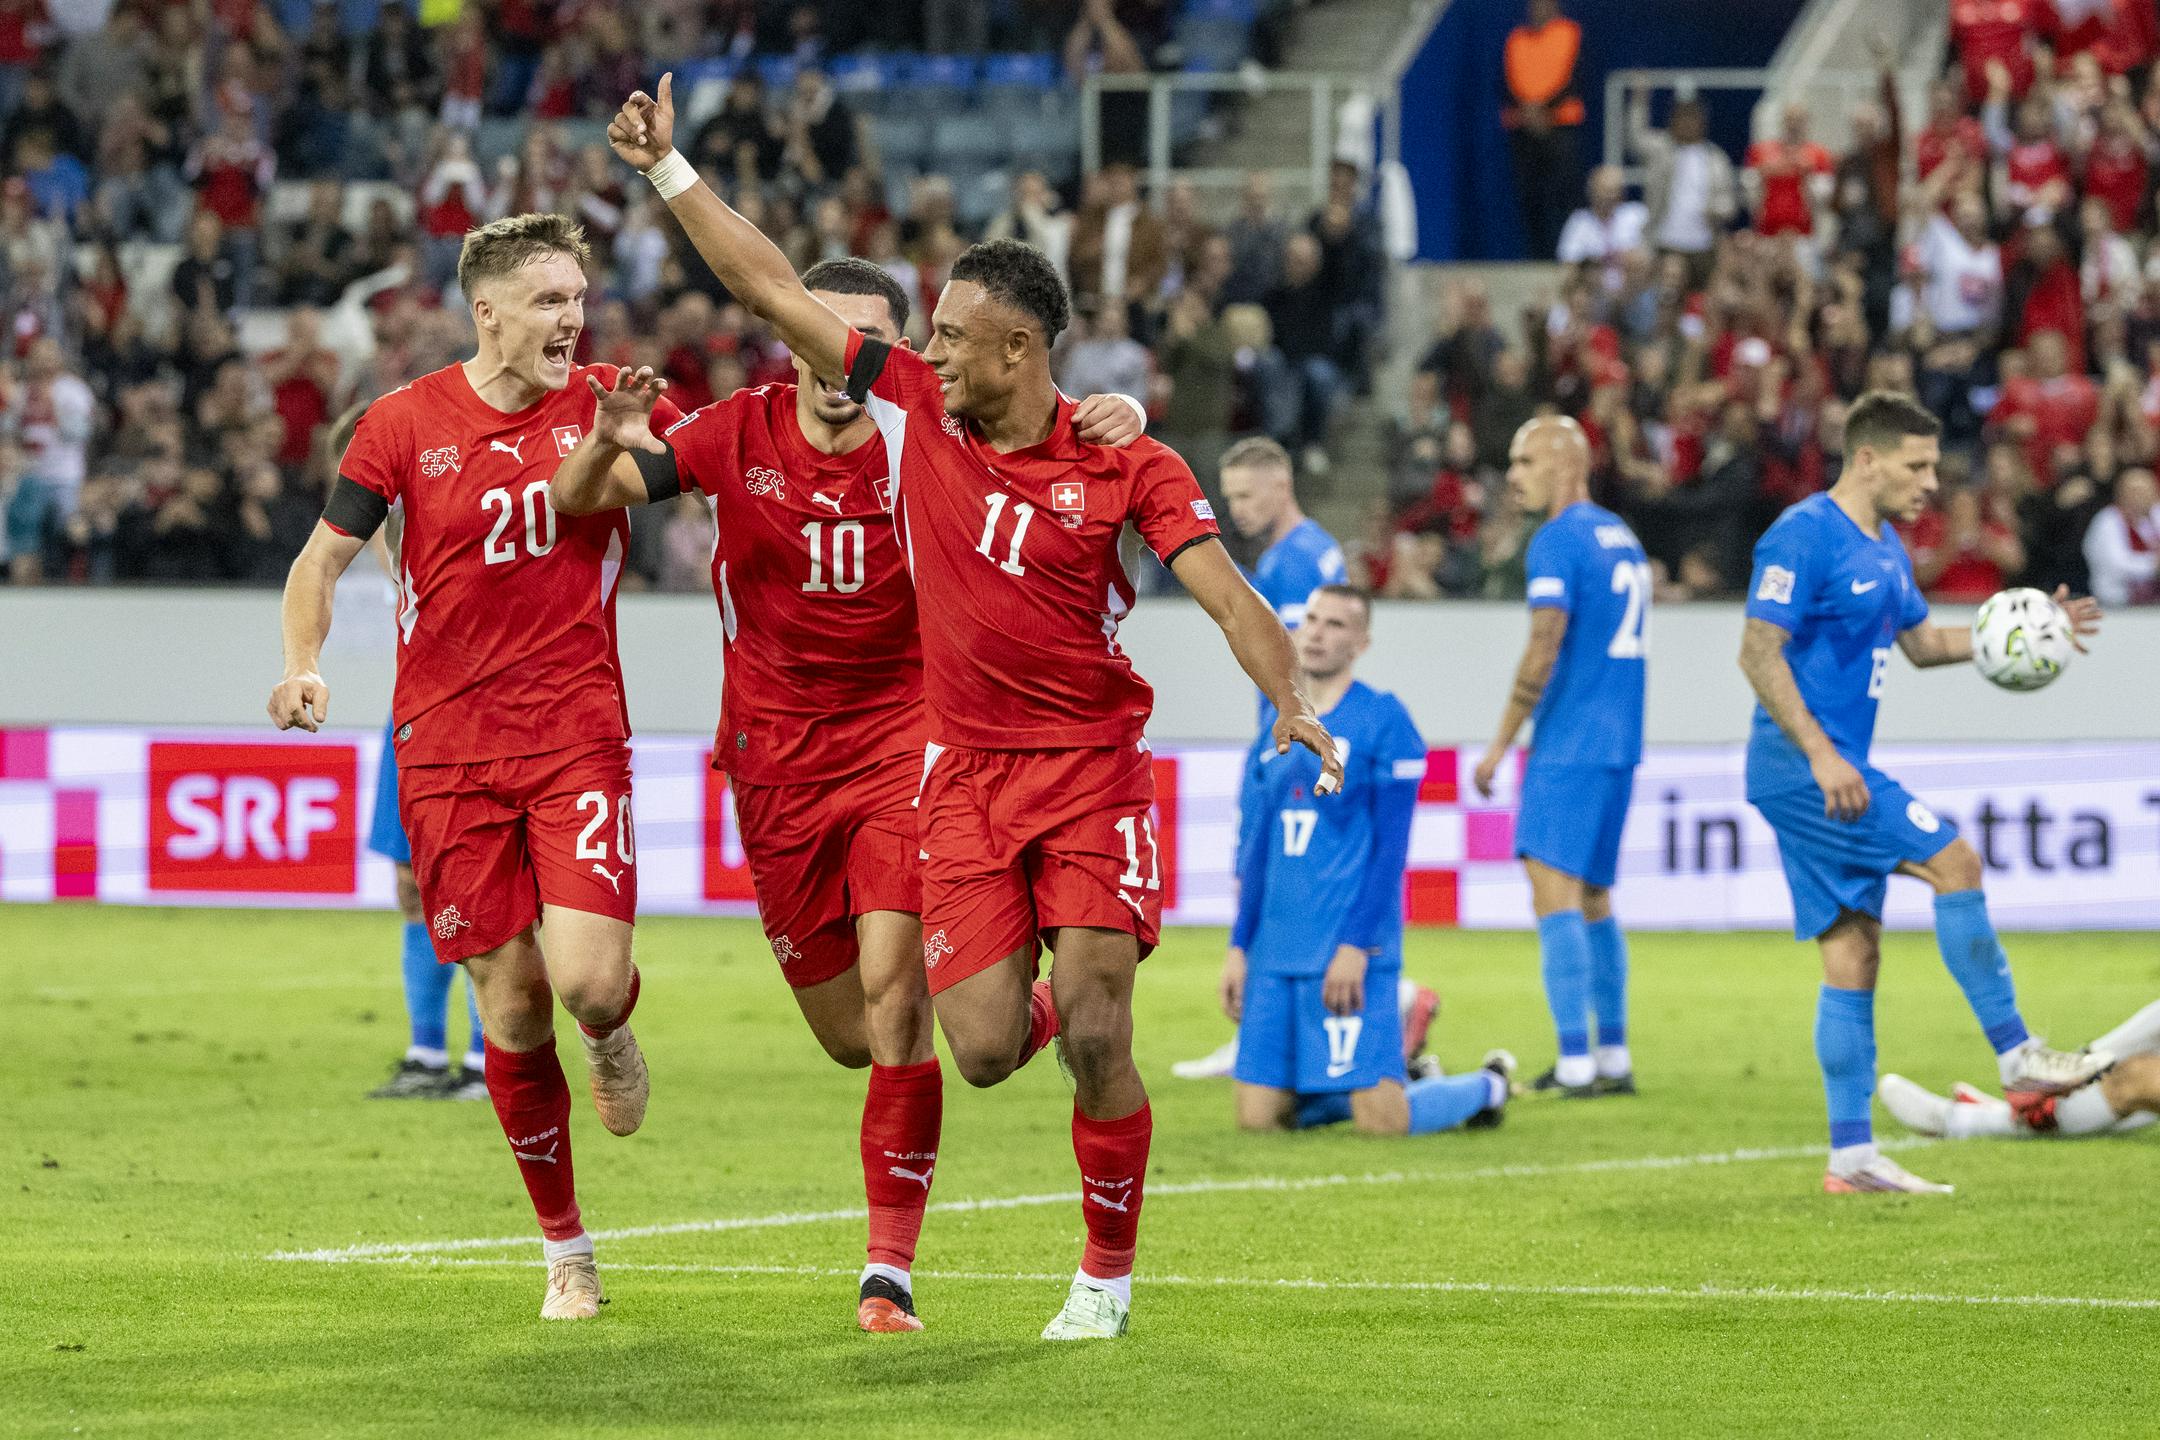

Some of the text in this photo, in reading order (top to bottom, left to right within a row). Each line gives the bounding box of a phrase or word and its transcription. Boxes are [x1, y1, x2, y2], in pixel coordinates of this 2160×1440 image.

[481, 480, 556, 565] 20
[800, 520, 865, 593] 10
[976, 492, 1034, 577] 11
[166, 774, 341, 861] SRF
[576, 791, 634, 865] 20
[1114, 816, 1160, 890] 11
[1280, 809, 1318, 856] 17
[1665, 790, 2113, 871] in tta
[1323, 1016, 1363, 1065] 17
